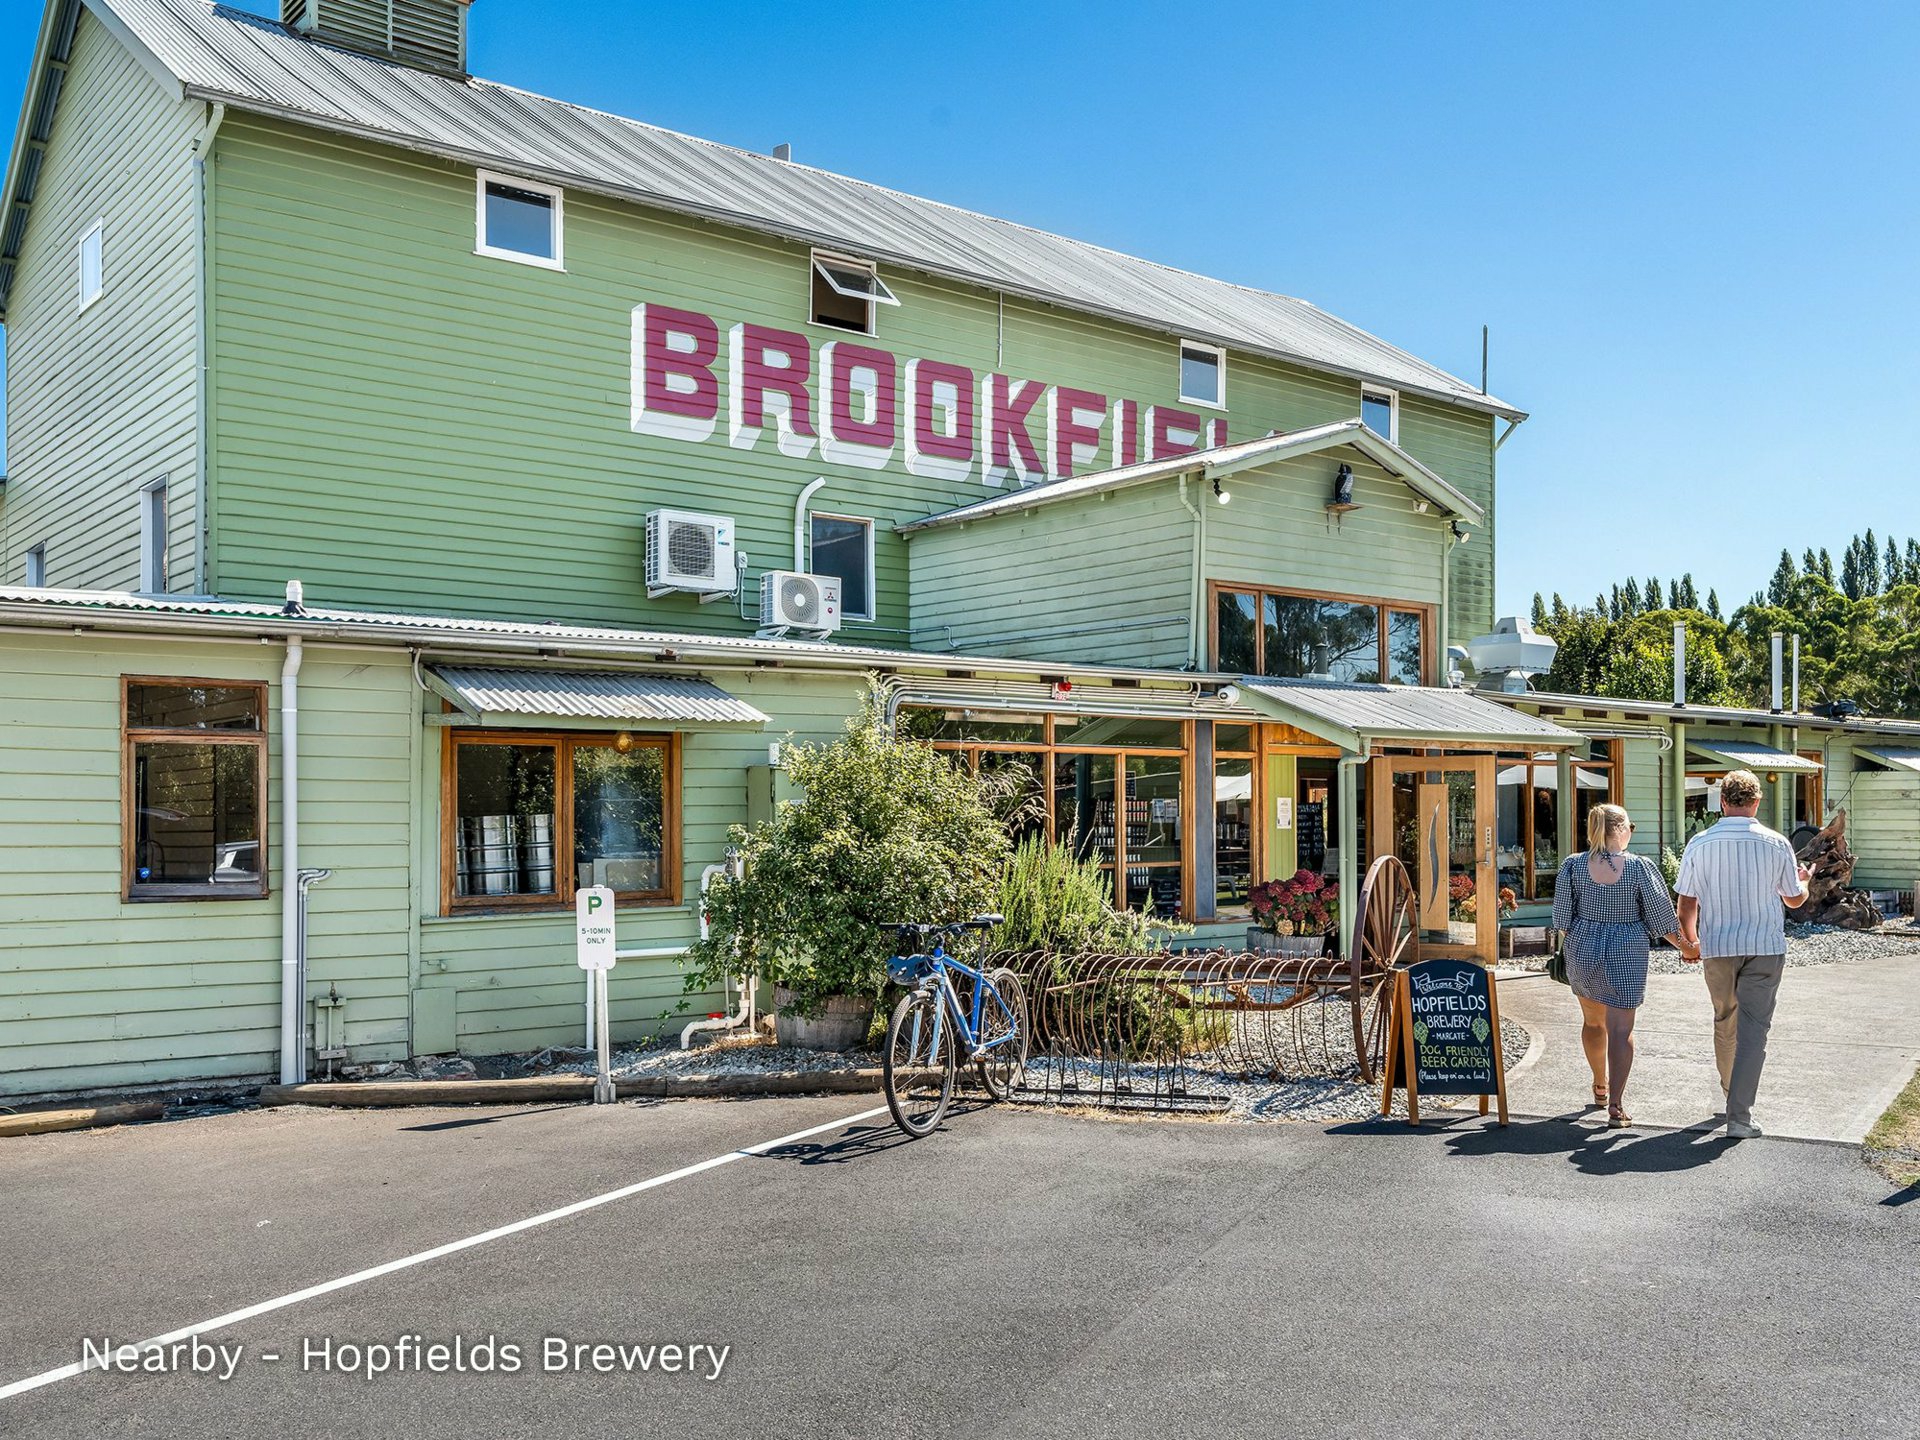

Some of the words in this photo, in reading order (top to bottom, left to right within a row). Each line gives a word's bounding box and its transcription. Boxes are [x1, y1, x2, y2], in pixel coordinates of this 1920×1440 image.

[630, 303, 1284, 488] BROOKFIE
[588, 896, 602, 914] P
[1411, 995, 1486, 1012] HOPFIELDS
[1426, 1015, 1472, 1028] BREWERY
[1420, 1045, 1441, 1055] DOG
[1445, 1046, 1490, 1056] FRIENDLY
[1421, 1056, 1449, 1067] BEER
[1450, 1056, 1490, 1068] GARDEN
